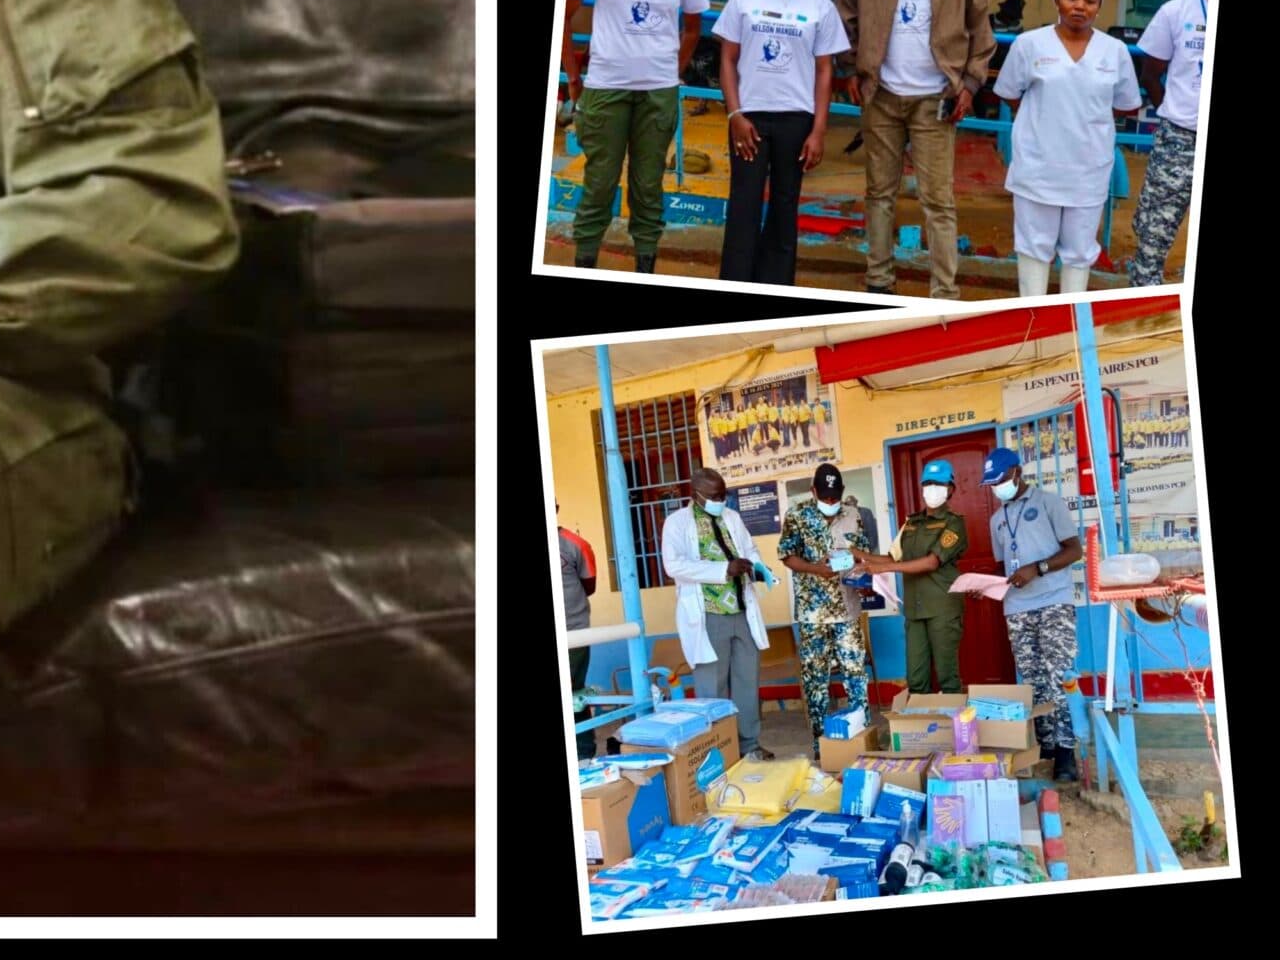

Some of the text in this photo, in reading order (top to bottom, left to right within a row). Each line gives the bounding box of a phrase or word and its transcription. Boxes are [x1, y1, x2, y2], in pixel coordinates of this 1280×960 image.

[751, 24, 774, 34] NELSON
[1024, 379, 1044, 391] LES
[1135, 355, 1159, 369] PCB
[895, 410, 976, 432] DIRECTEUR
